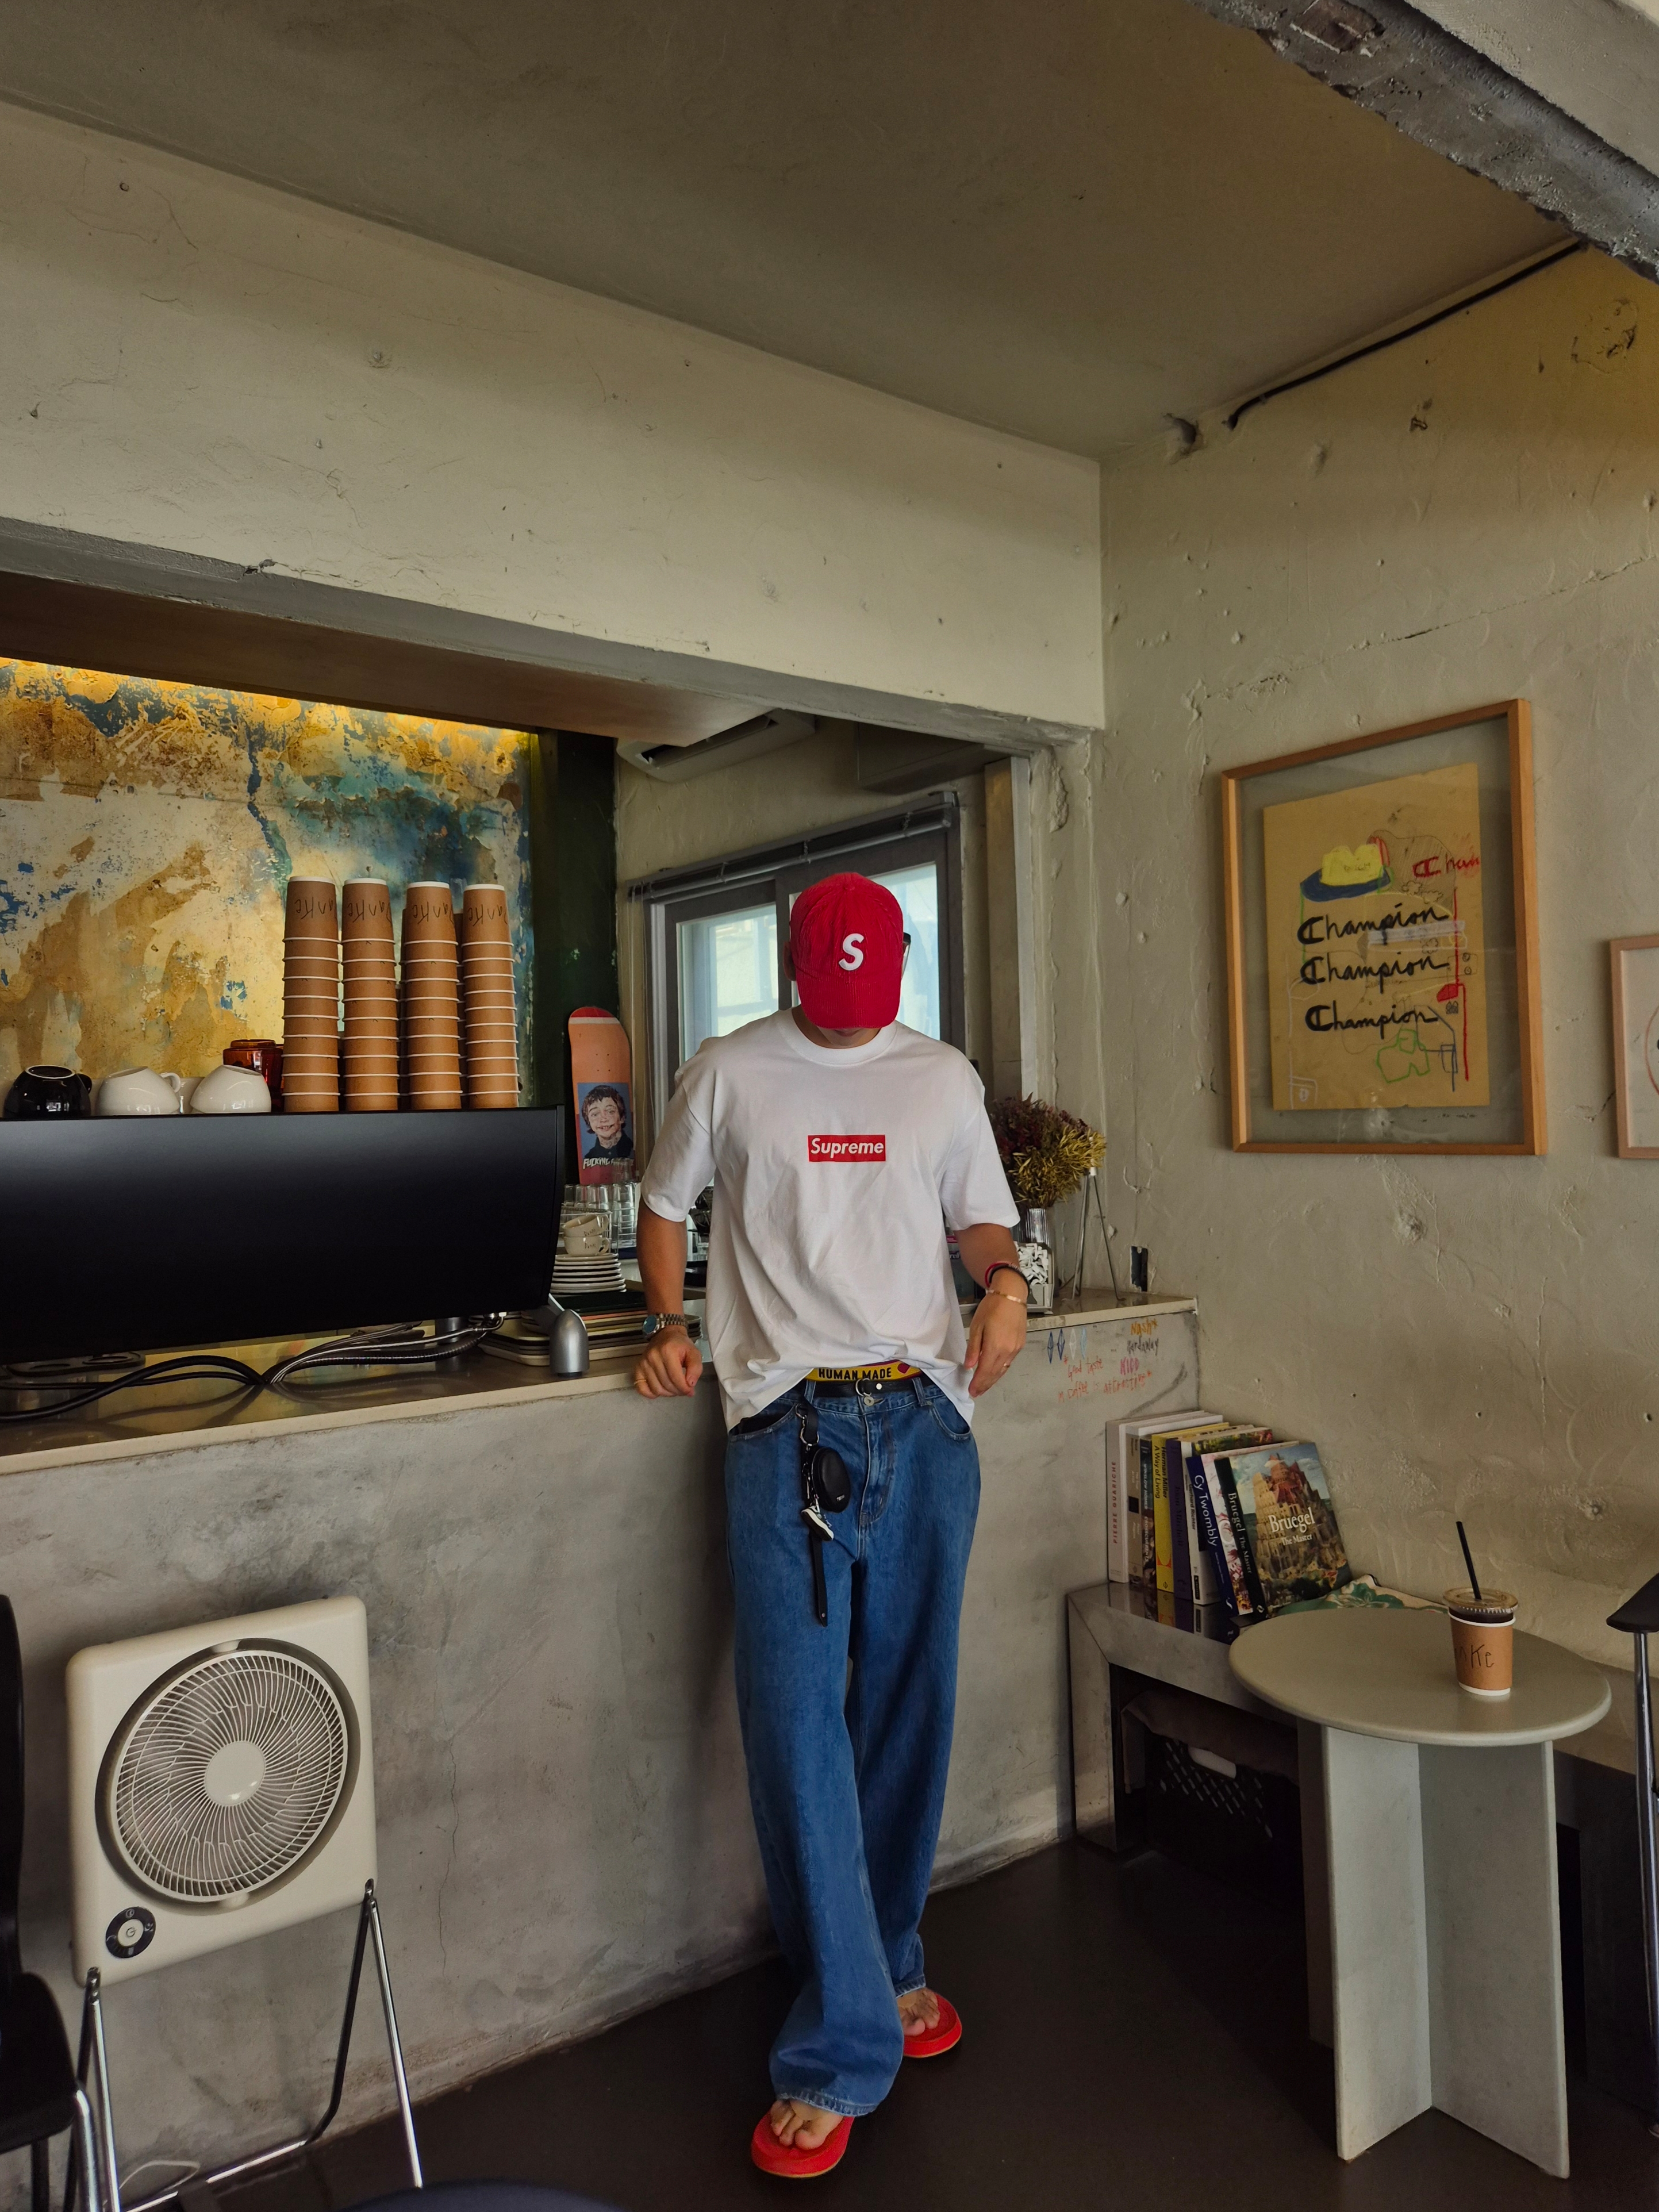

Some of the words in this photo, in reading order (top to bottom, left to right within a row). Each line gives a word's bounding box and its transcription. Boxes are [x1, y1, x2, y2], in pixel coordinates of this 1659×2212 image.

[1297, 903, 1449, 946] Champion
[838, 933, 865, 971] S
[1300, 953, 1449, 993] Champion
[1305, 1000, 1438, 1039] Champion
[811, 1137, 884, 1159] Supreme
[818, 1368, 858, 1380] HUMAN
[863, 1367, 892, 1380] MADE
[1154, 1468, 1161, 1477] of
[1194, 1474, 1204, 1490] Cy
[1199, 1492, 1218, 1547] Twombly
[1268, 1506, 1316, 1533] Bruegel
[1228, 1492, 1246, 1533] Bruegel
[1242, 1550, 1253, 1574] Master
[1293, 1534, 1313, 1543] Master
